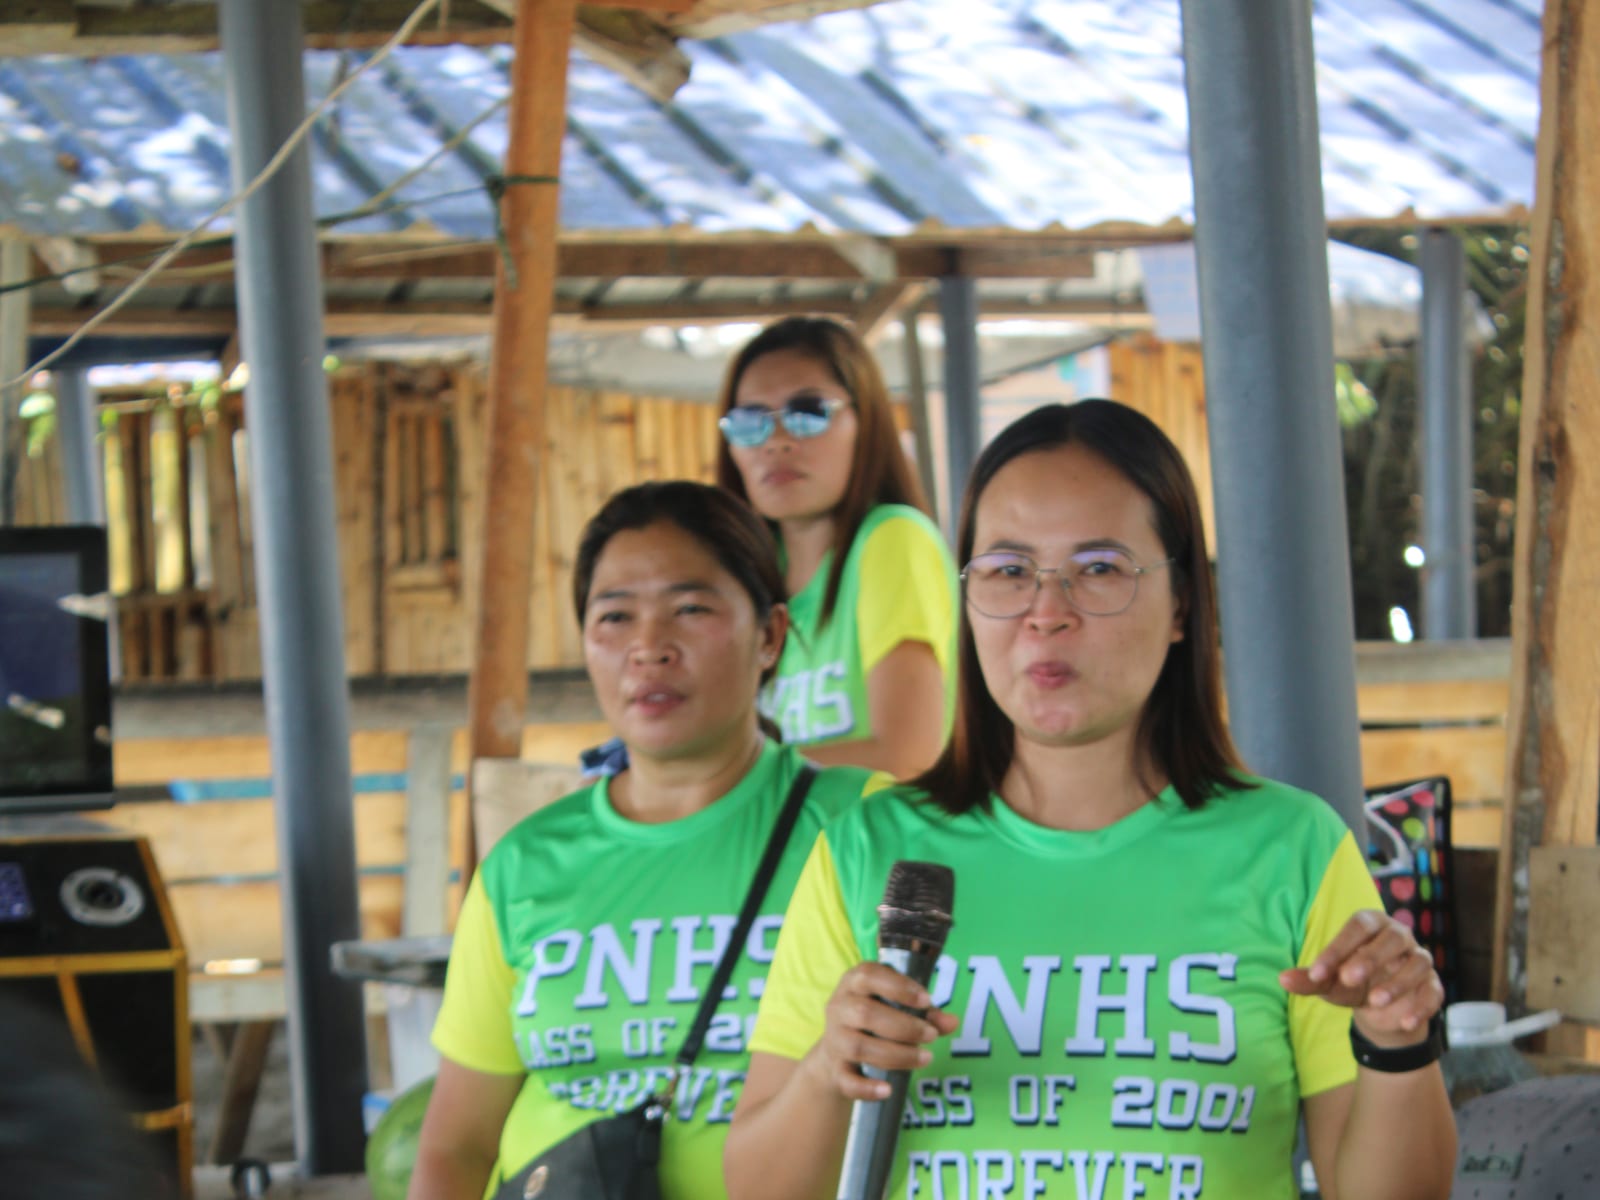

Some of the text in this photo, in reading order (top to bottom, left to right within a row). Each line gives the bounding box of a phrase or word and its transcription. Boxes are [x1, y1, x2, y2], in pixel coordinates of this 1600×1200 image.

[514, 1023, 596, 1069] ASS
[622, 1017, 677, 1060] OF
[902, 1075, 1256, 1133] ASS OF 2001
